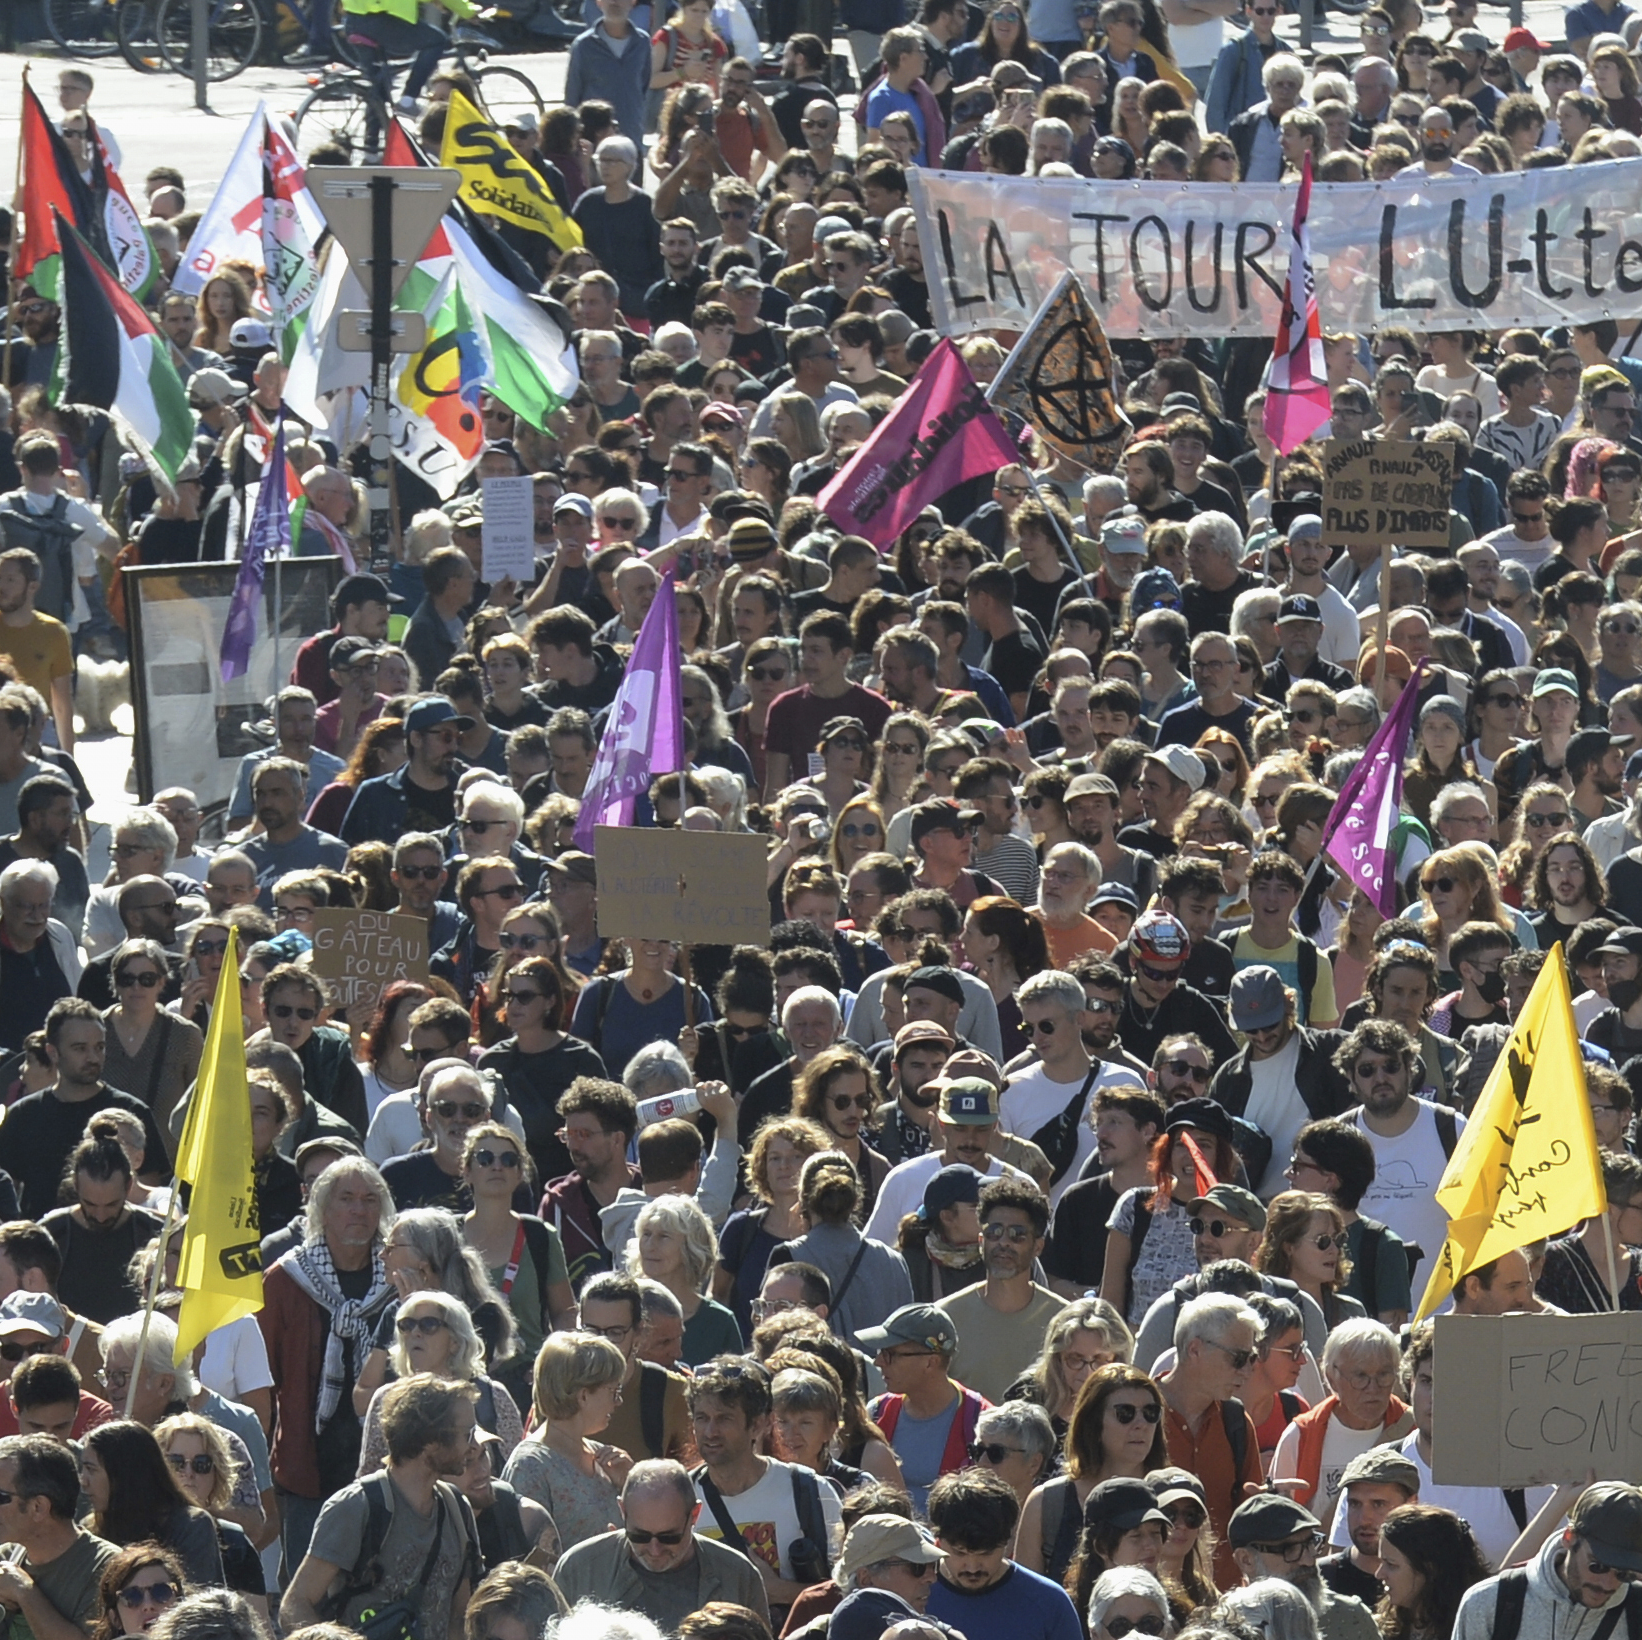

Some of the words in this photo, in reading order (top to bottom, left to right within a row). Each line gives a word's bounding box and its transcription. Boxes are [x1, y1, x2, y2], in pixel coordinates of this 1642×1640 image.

[938, 208, 1026, 307] LA
[1072, 211, 1286, 313] TOUR
[1326, 507, 1370, 534] PLUS
[359, 914, 390, 932] DU
[672, 900, 766, 927] RÉVOLTE
[315, 920, 420, 961] GÂTEAU
[345, 955, 408, 980] POUR
